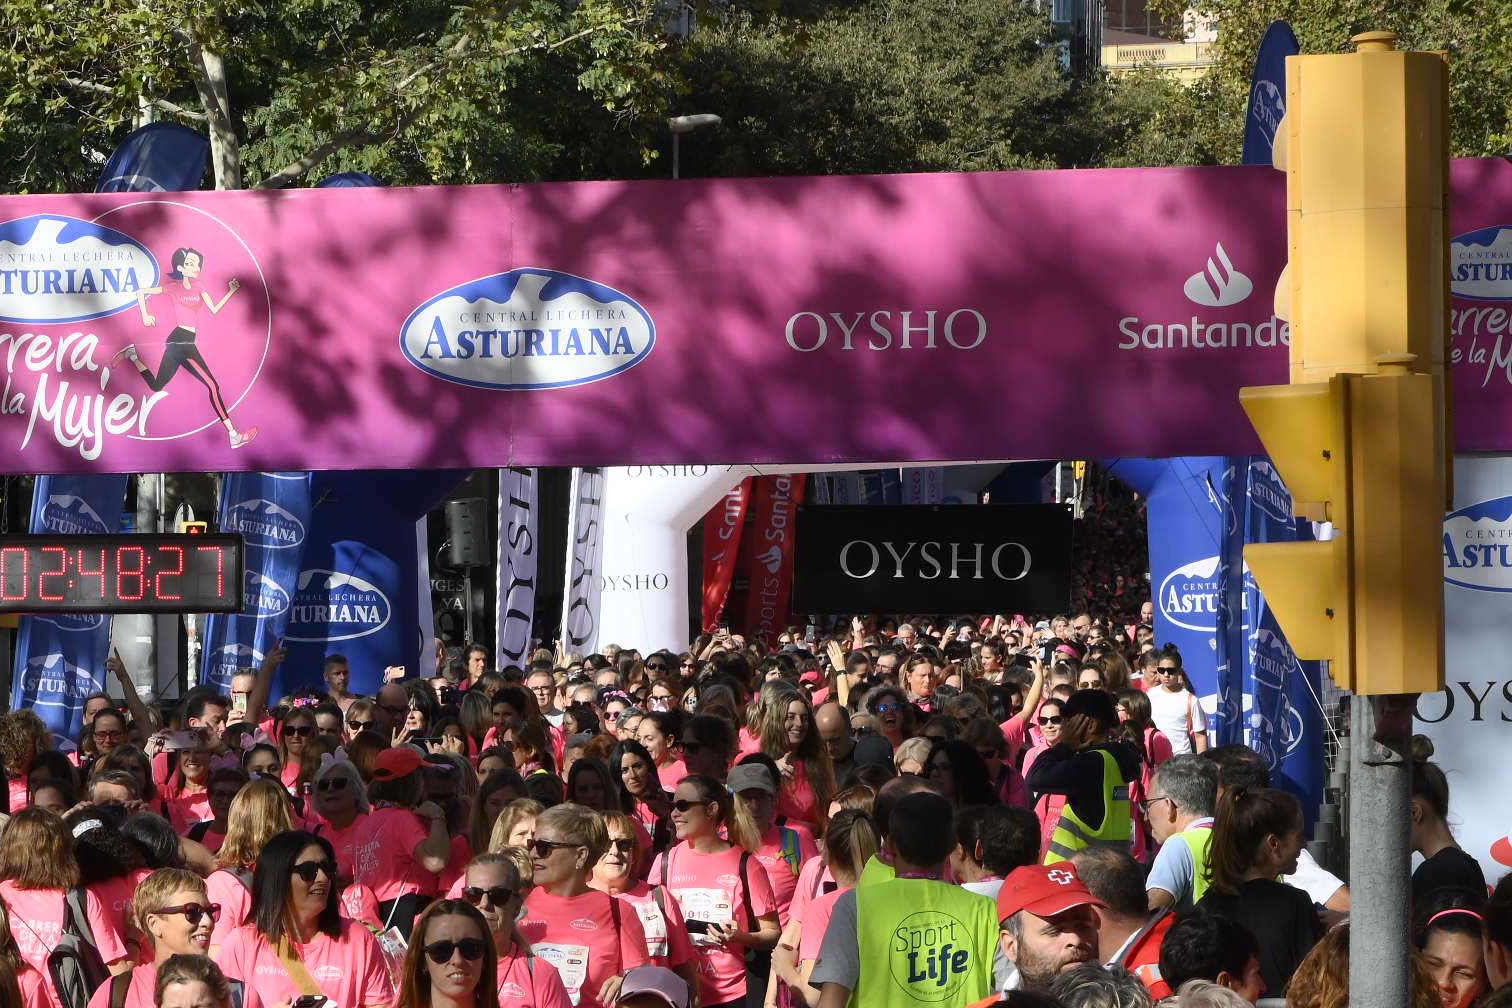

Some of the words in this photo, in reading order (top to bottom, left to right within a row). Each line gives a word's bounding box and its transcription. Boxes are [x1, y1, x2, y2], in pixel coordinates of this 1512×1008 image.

[63, 251, 135, 262] LECHERA
[459, 310, 538, 323] CENTRAL
[546, 308, 627, 321] LECHERA
[784, 307, 987, 352] OYSHO
[1119, 315, 1291, 350] Santande
[420, 315, 635, 360] ASTURIANA
[1468, 337, 1487, 363] la
[1, 376, 25, 415] la
[21, 367, 169, 461] Mujer
[227, 512, 297, 543] ASTURIANA
[0, 546, 224, 601] 02:48:27
[839, 540, 1032, 581] OYSHO
[244, 592, 281, 611] RIANA
[289, 605, 381, 624] TURIANA
[328, 593, 377, 602] LECHERA
[896, 920, 957, 955] Sport
[908, 944, 969, 987] Life
